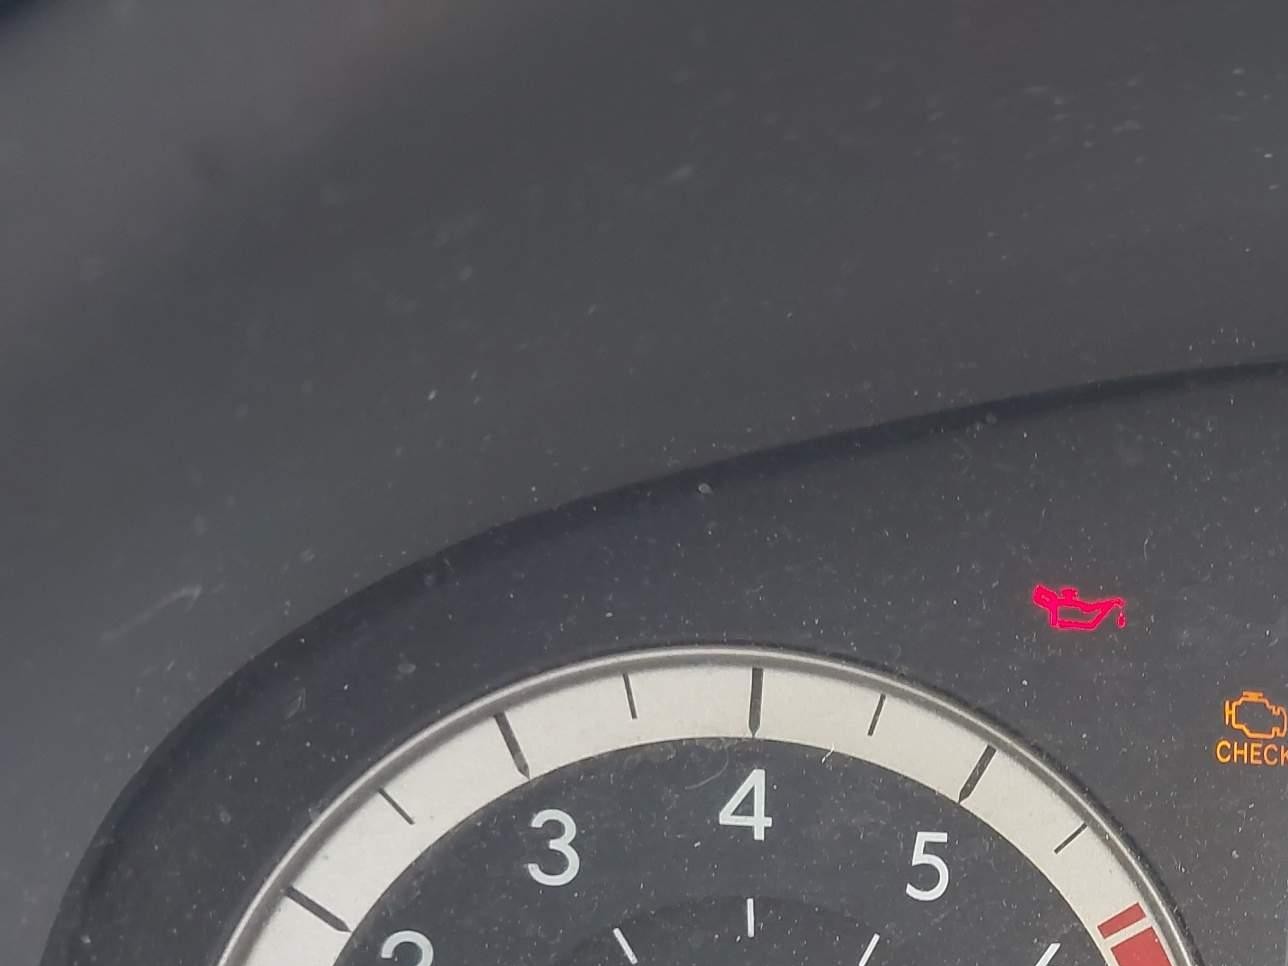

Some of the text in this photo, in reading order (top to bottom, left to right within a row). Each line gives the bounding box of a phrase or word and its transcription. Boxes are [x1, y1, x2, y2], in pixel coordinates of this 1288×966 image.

[719, 769, 772, 840] 4
[528, 809, 580, 886] 3
[905, 831, 949, 901] 5
